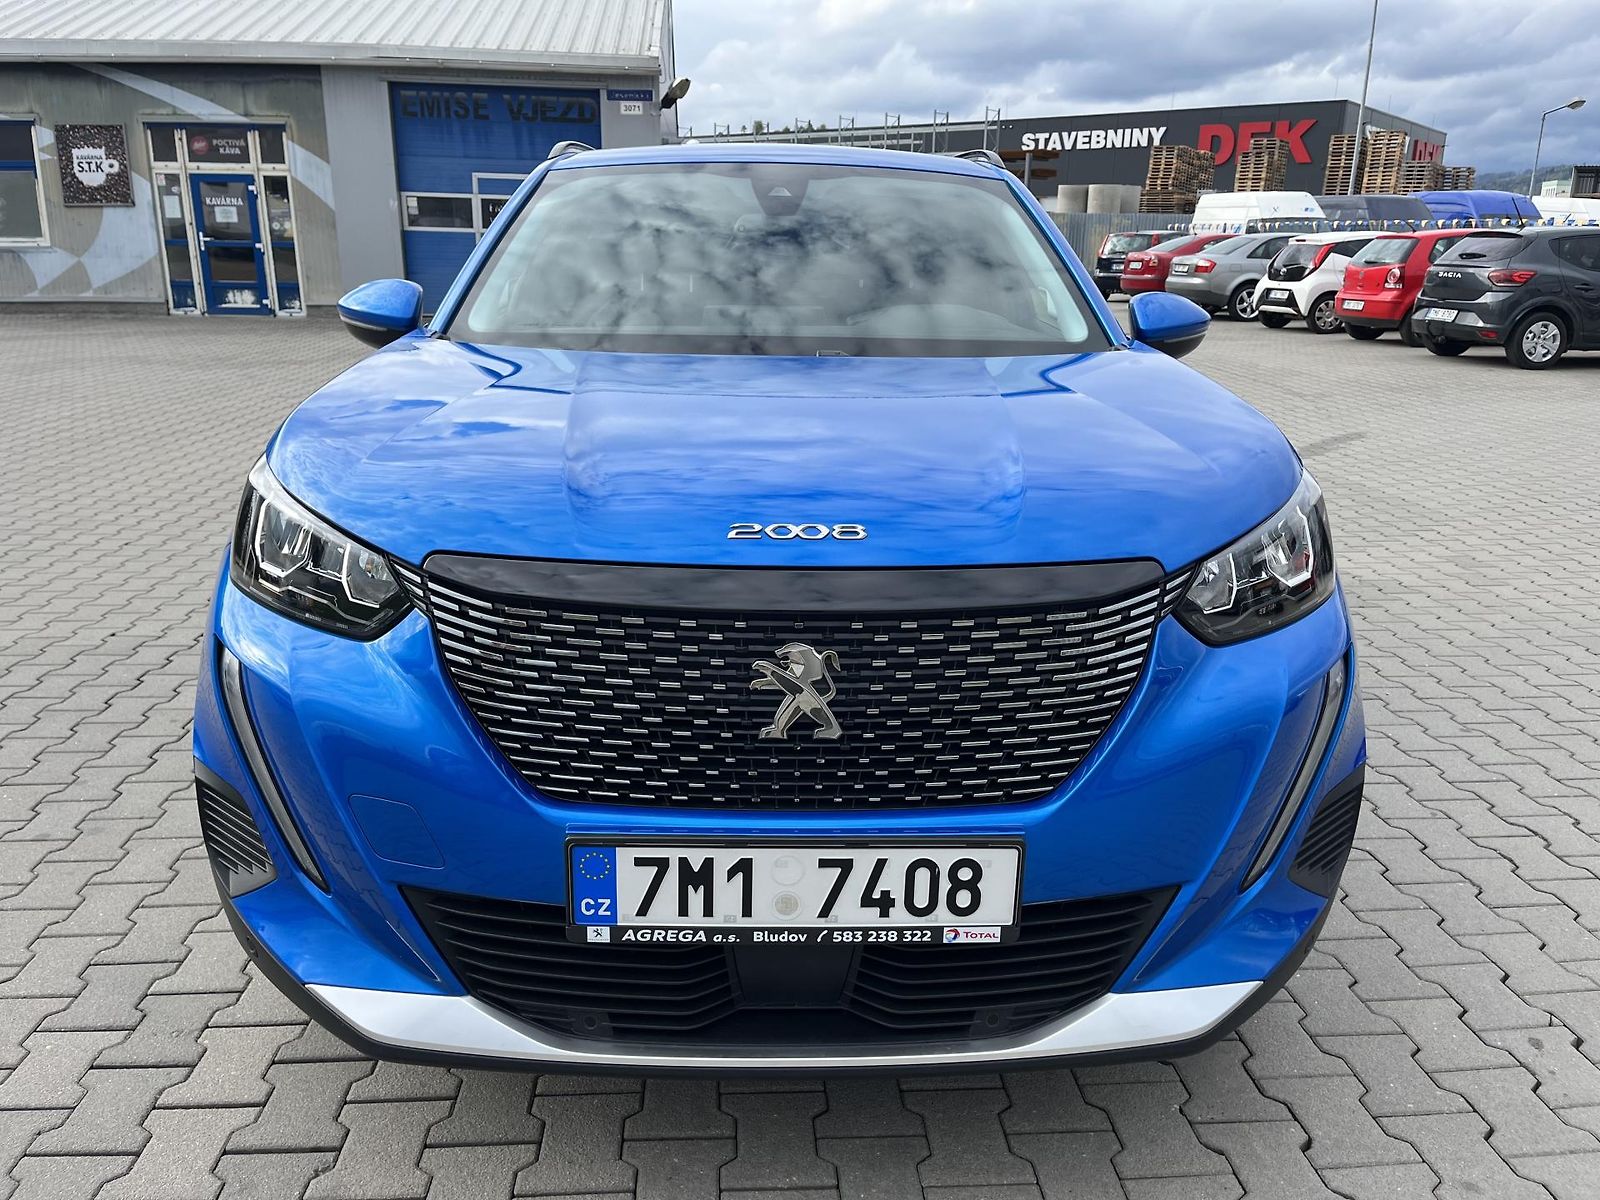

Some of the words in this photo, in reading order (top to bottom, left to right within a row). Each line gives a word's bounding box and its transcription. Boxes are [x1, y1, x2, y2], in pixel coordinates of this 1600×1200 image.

[401, 90, 490, 121] EMISE
[502, 94, 598, 124] VJEZD
[623, 104, 641, 112] 3071
[1021, 126, 1168, 152] STAVEBNINY
[205, 195, 244, 206] KAVÁRNA
[1438, 271, 1462, 279] DACIA
[727, 523, 868, 540] 2008
[633, 857, 753, 918] 7M1
[816, 857, 984, 919] 7408
[580, 898, 612, 916] CZ
[622, 929, 707, 942] AGREGA
[713, 934, 740, 943] a.s.
[753, 931, 807, 943] Bludov
[832, 931, 863, 943] 583
[867, 931, 898, 942] 238
[902, 930, 932, 942] 322
